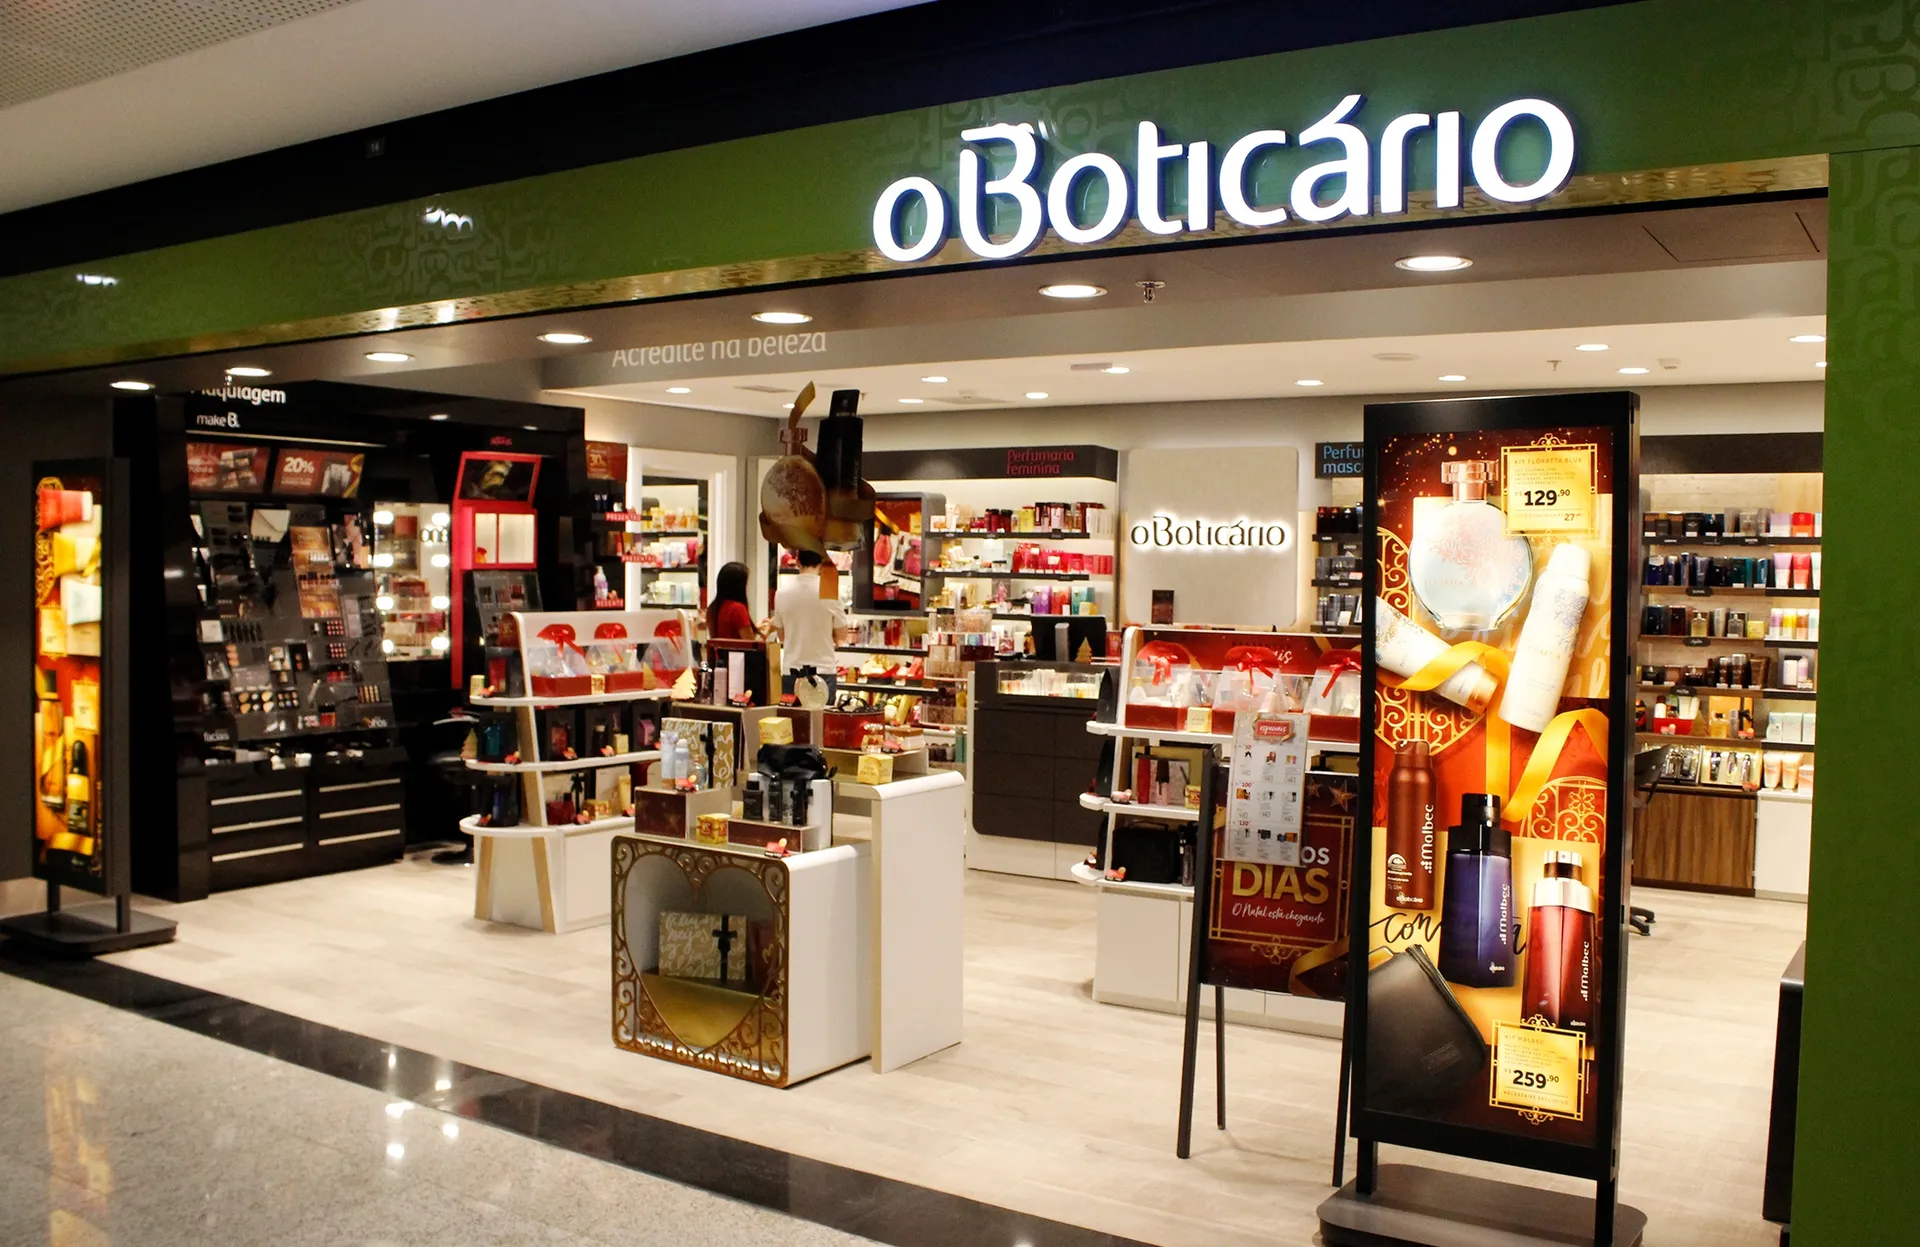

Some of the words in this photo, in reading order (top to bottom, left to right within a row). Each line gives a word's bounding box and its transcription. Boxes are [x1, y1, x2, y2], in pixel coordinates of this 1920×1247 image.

[711, 339, 740, 360] na
[747, 332, 828, 358] beleza
[196, 414, 227, 427] make
[1007, 449, 1075, 462] Perfumaria
[1323, 444, 1364, 459] Perfu
[283, 456, 315, 474] 20%
[1006, 462, 1061, 475] feminina
[1323, 462, 1364, 474] masc
[1232, 863, 1330, 905] DIAS
[1232, 902, 1243, 916] O
[1242, 902, 1268, 918] Natal
[1285, 909, 1325, 926] chegando
